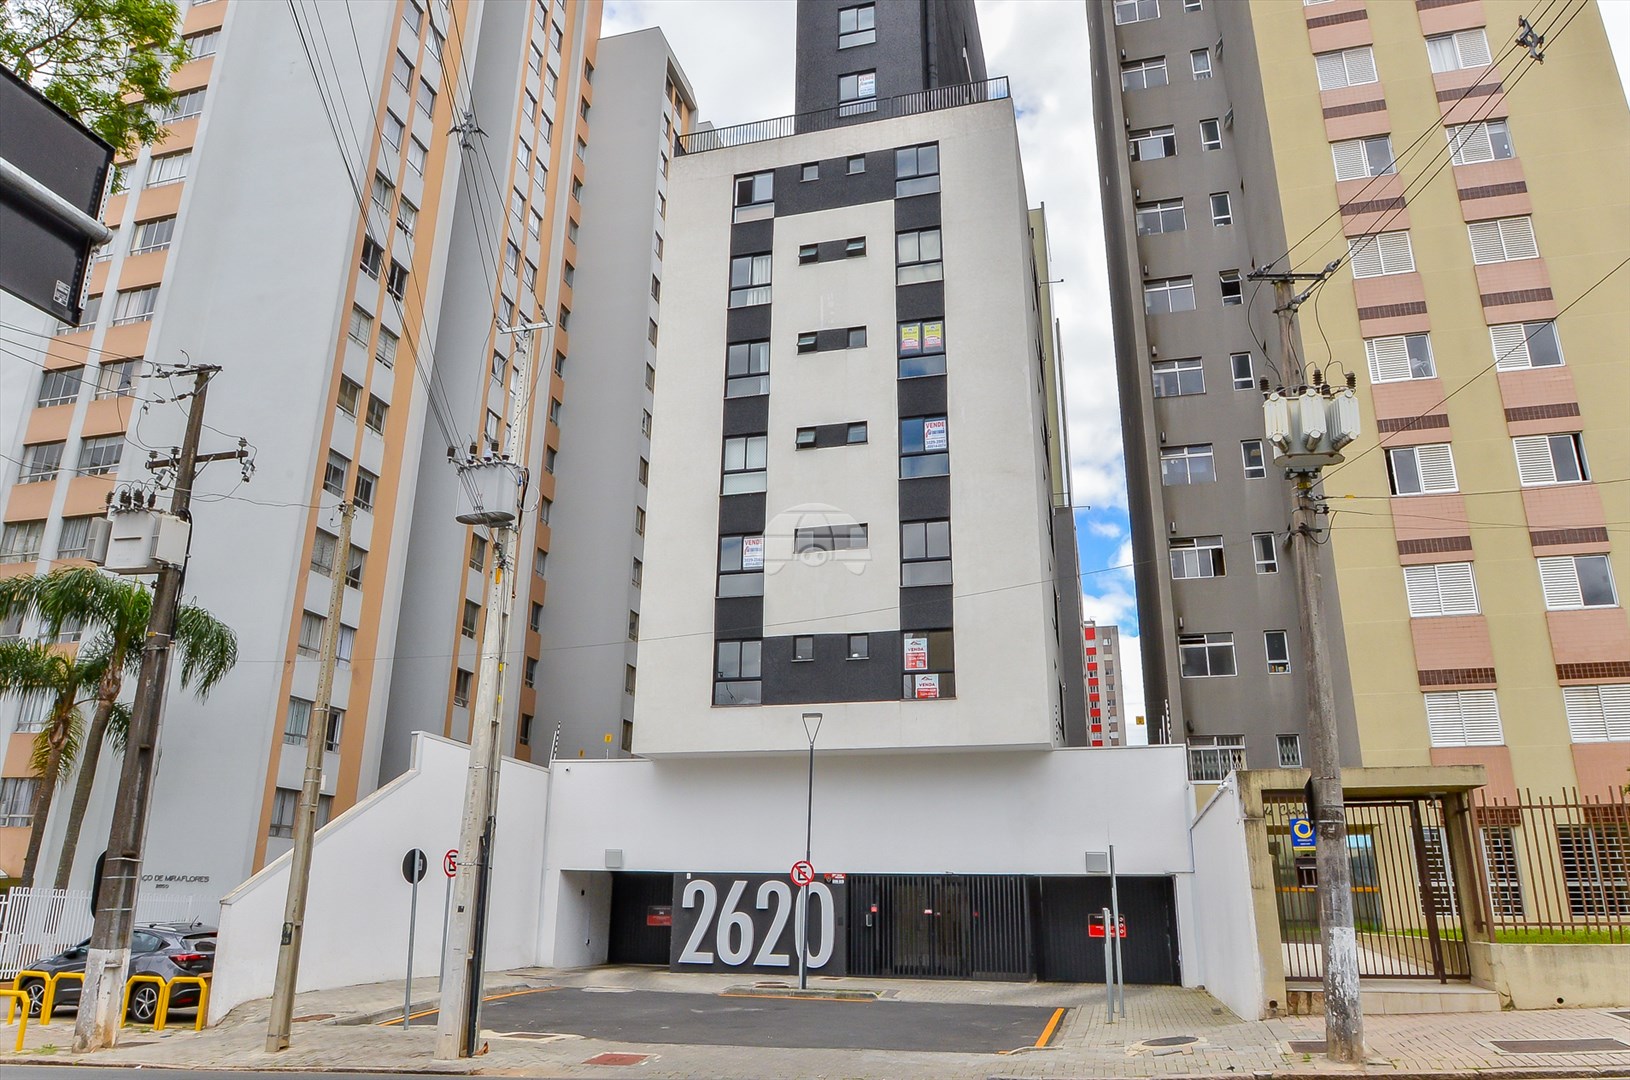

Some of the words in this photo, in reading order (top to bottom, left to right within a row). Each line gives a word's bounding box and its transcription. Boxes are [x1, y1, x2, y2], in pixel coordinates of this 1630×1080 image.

[925, 421, 945, 429] VENDE
[154, 874, 164, 882] DE
[164, 874, 210, 883] MIRAFLORES
[678, 879, 835, 969] 2620
